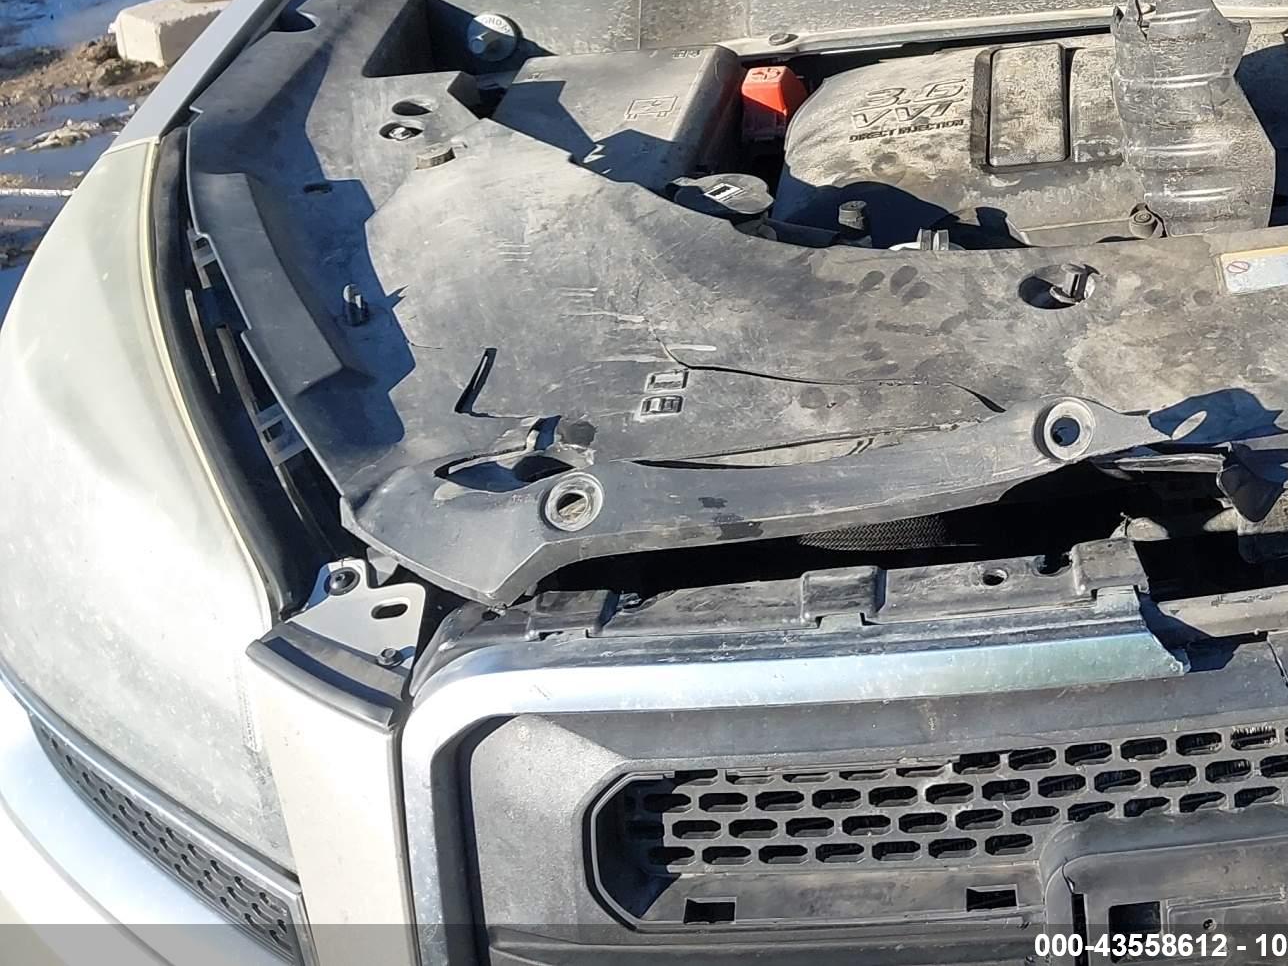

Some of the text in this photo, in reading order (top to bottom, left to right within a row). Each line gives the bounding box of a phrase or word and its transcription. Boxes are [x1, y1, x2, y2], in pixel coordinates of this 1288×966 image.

[857, 78, 967, 111] 3.6
[852, 99, 964, 129] VVT
[849, 118, 965, 143] DIRECT INJECTION
